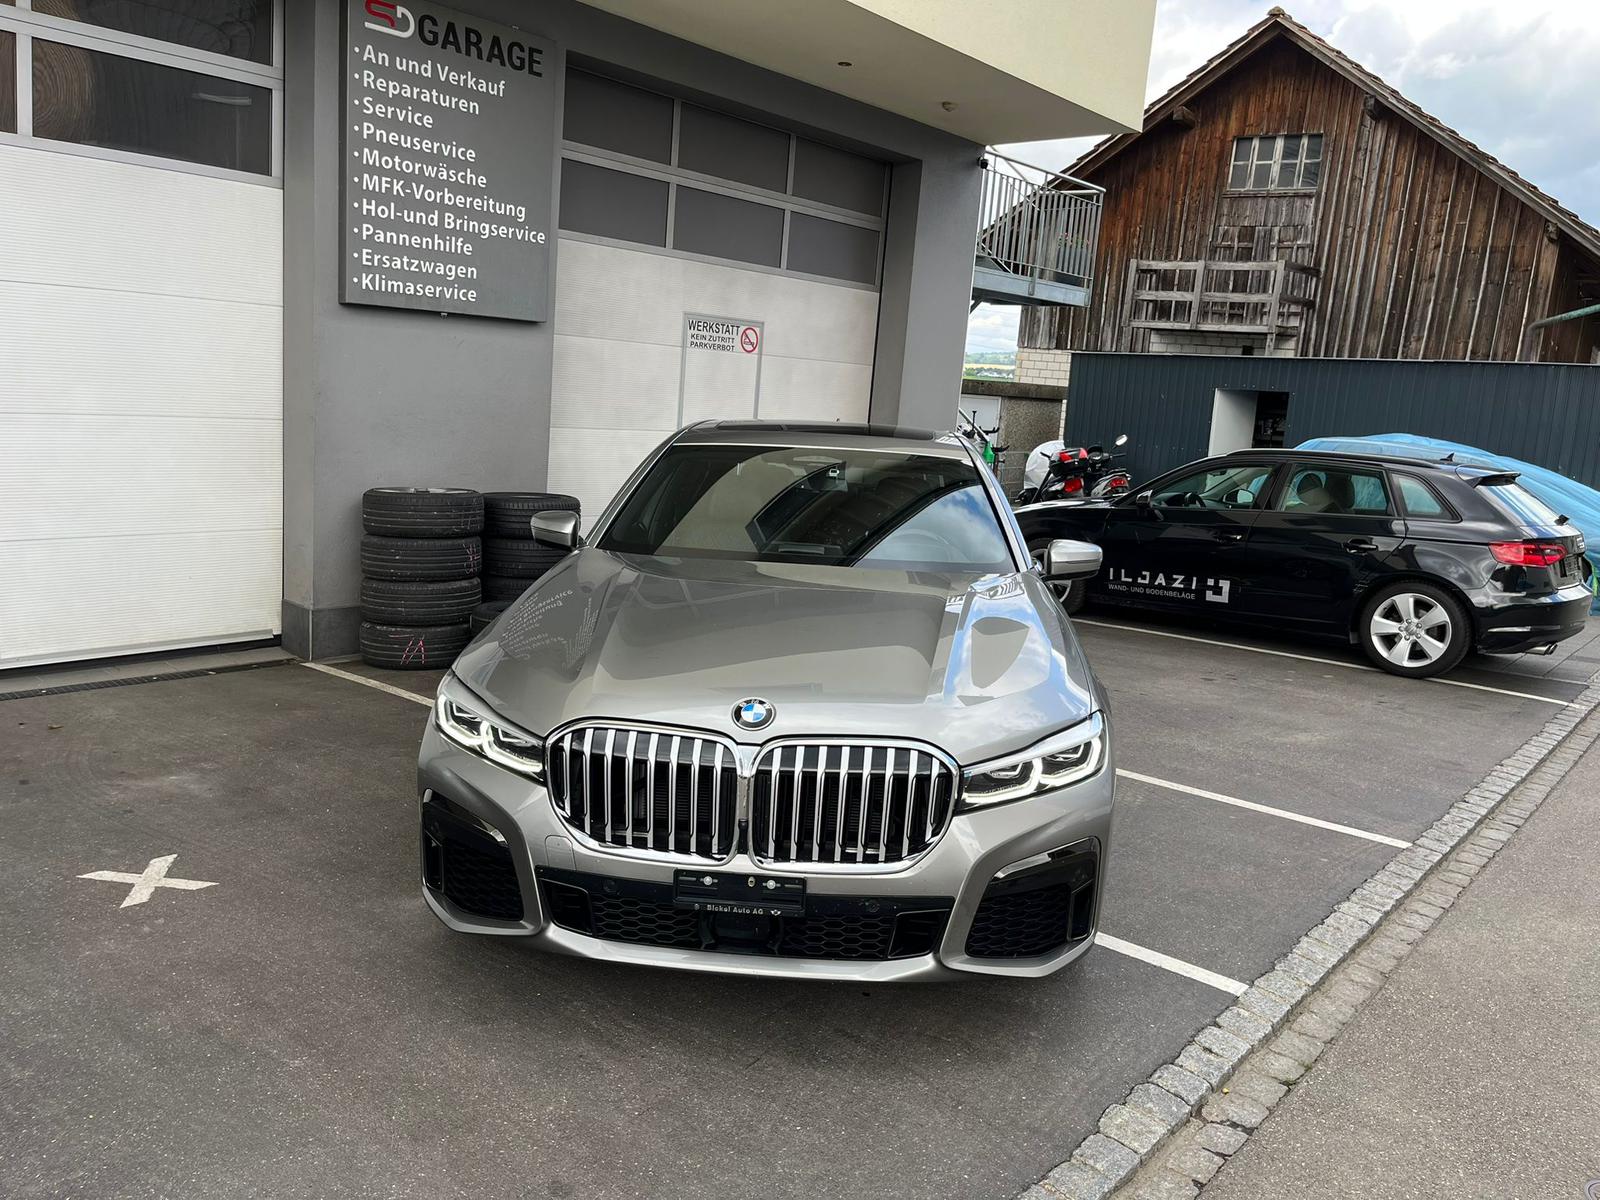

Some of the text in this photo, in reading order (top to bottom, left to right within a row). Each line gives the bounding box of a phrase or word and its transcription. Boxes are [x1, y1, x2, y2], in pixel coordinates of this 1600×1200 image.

[418, 14, 543, 78] GARAGE
[362, 44, 506, 98] An und Verkauf
[362, 70, 480, 115] Reparaturen
[362, 97, 434, 129] Service
[362, 122, 476, 163] Pneuservice
[362, 147, 488, 188] Motorwäsche
[362, 173, 526, 222] MFK-Vorbereitung
[362, 198, 546, 244] Hol-und Bringservice
[361, 223, 473, 256] Pannenhilfe
[361, 249, 478, 280] Ersatzwagen
[361, 273, 477, 302] Klimaservice
[688, 320, 741, 336] WERKSTATT
[690, 333, 735, 344] KEIN ZUTRITT
[690, 341, 735, 352] PARKVERBOT
[1109, 567, 1197, 590] ILJAZI
[1130, 586, 1145, 594] UND
[732, 906, 751, 914] Auto
